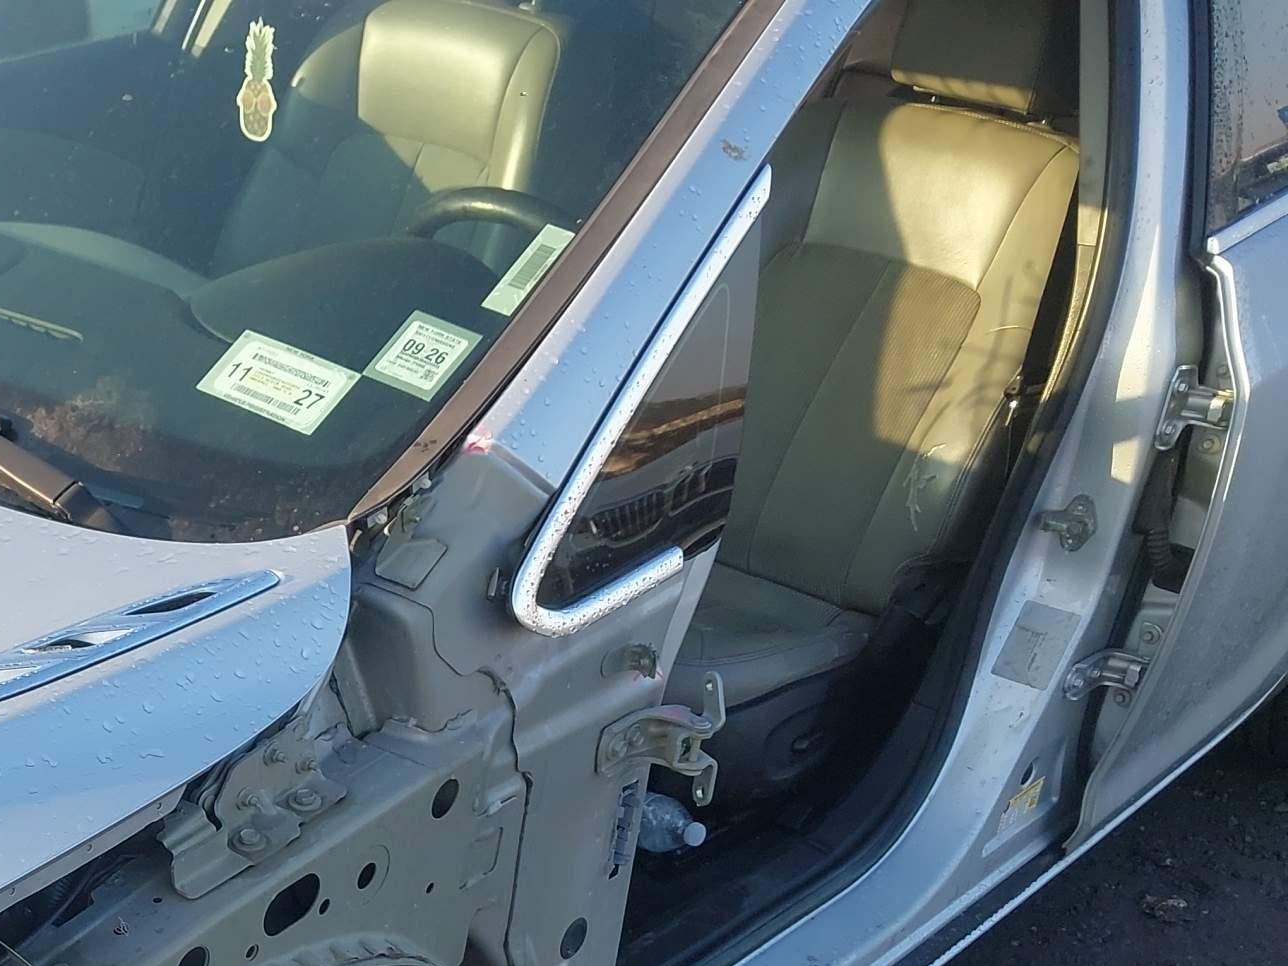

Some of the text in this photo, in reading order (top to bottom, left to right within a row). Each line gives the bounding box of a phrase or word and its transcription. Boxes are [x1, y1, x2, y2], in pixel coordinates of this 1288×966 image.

[402, 338, 426, 355] 09
[424, 347, 449, 365] 26
[227, 361, 253, 382] 11
[293, 388, 325, 410] 27
